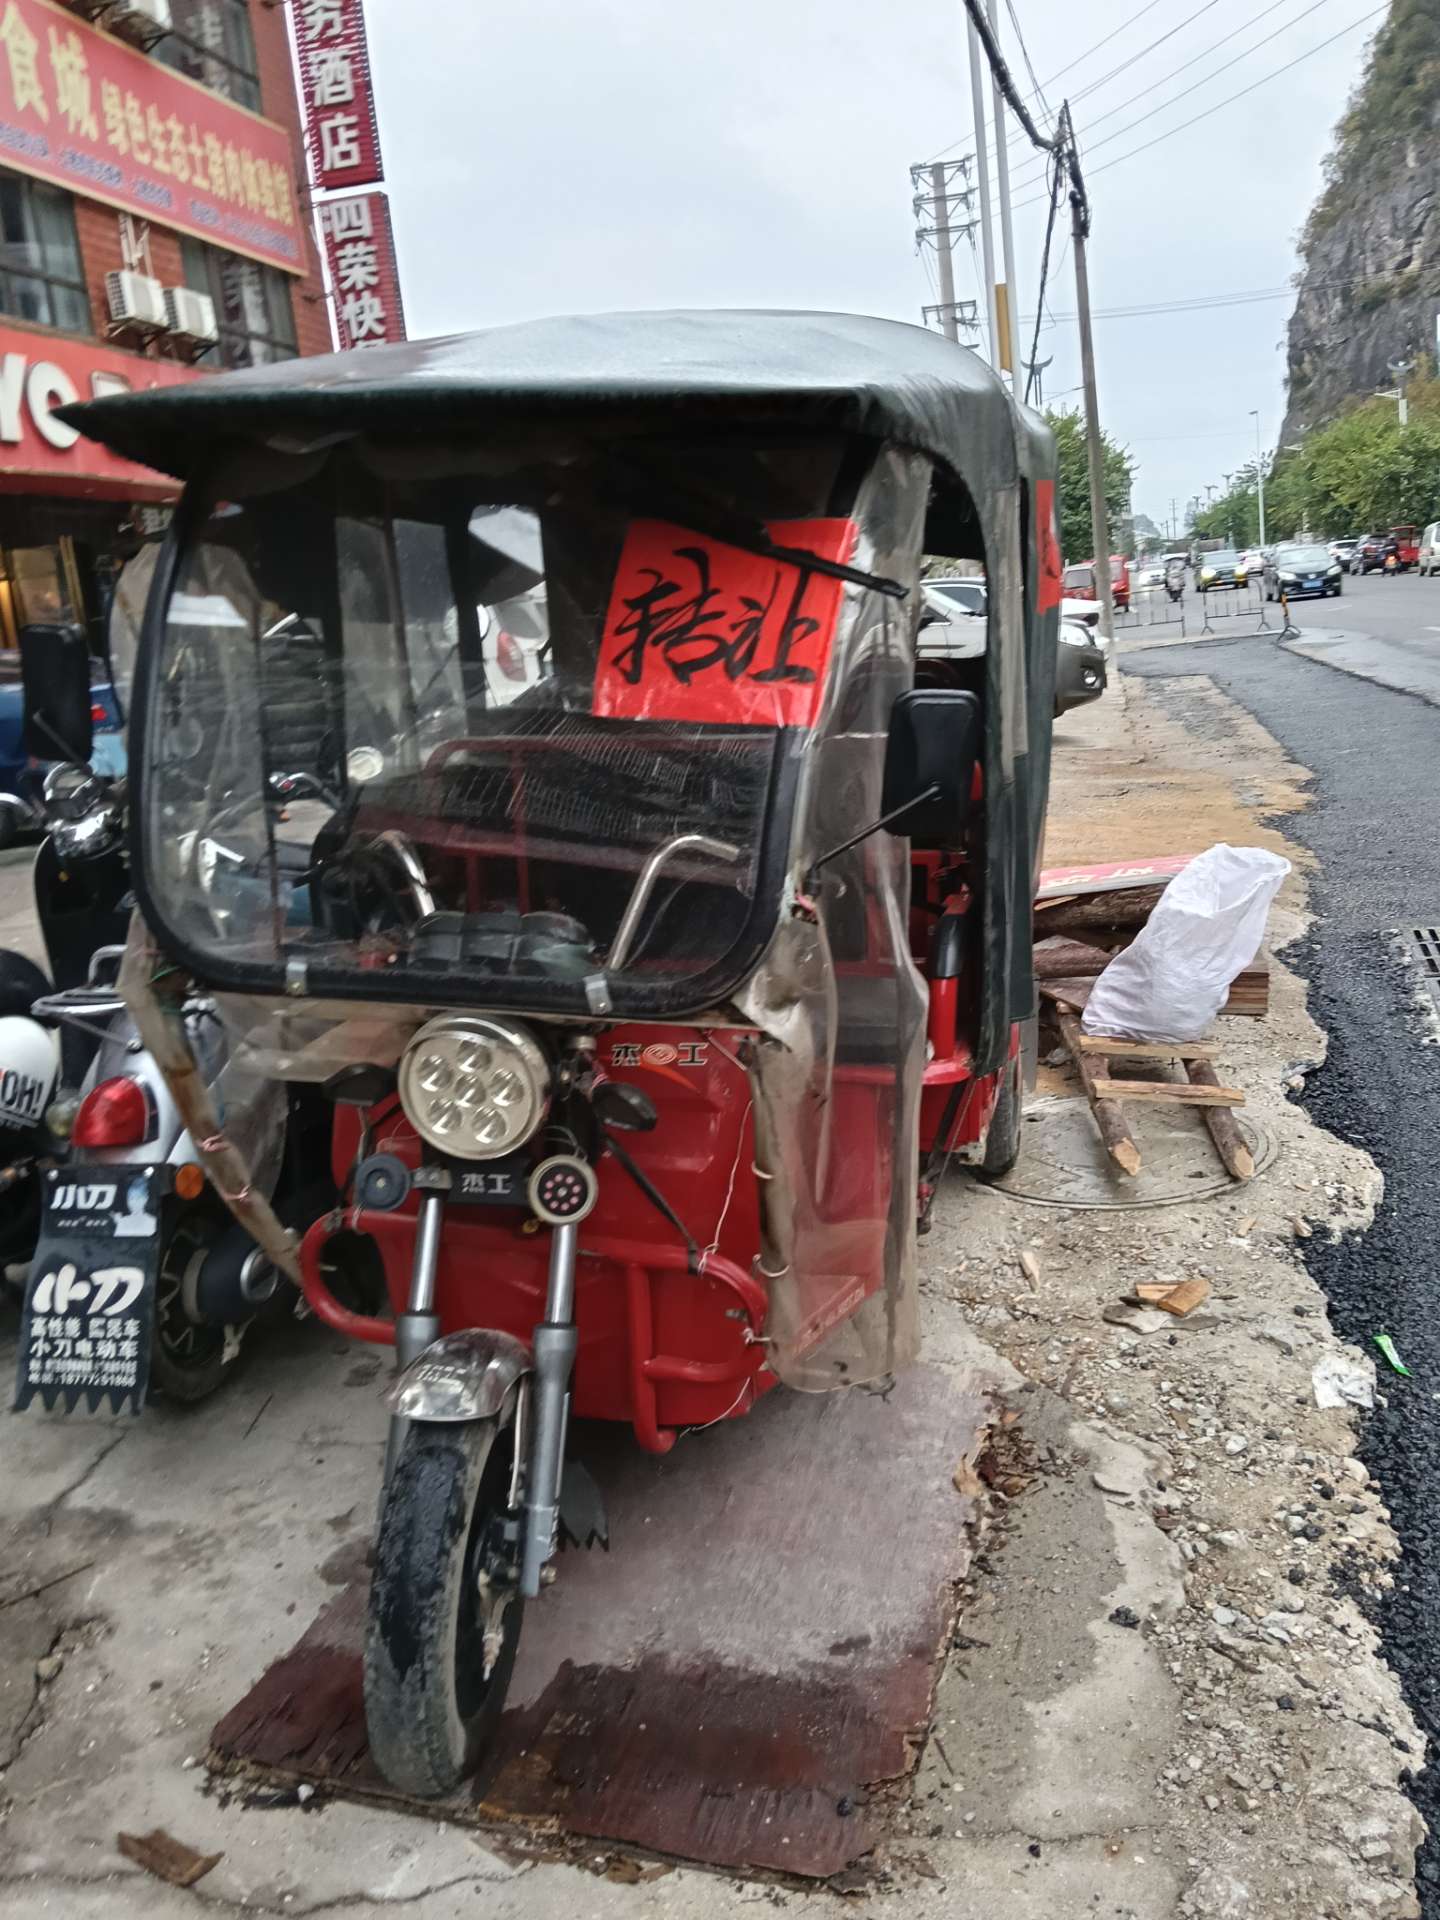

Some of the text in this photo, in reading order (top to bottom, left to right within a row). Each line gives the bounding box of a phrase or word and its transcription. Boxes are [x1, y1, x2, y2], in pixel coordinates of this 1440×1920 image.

[330, 197, 388, 350] 四荣快
[612, 547, 822, 686] 转让
[32, 1263, 145, 1316] 小刀
[29, 1337, 139, 1359] 小刀电动车
